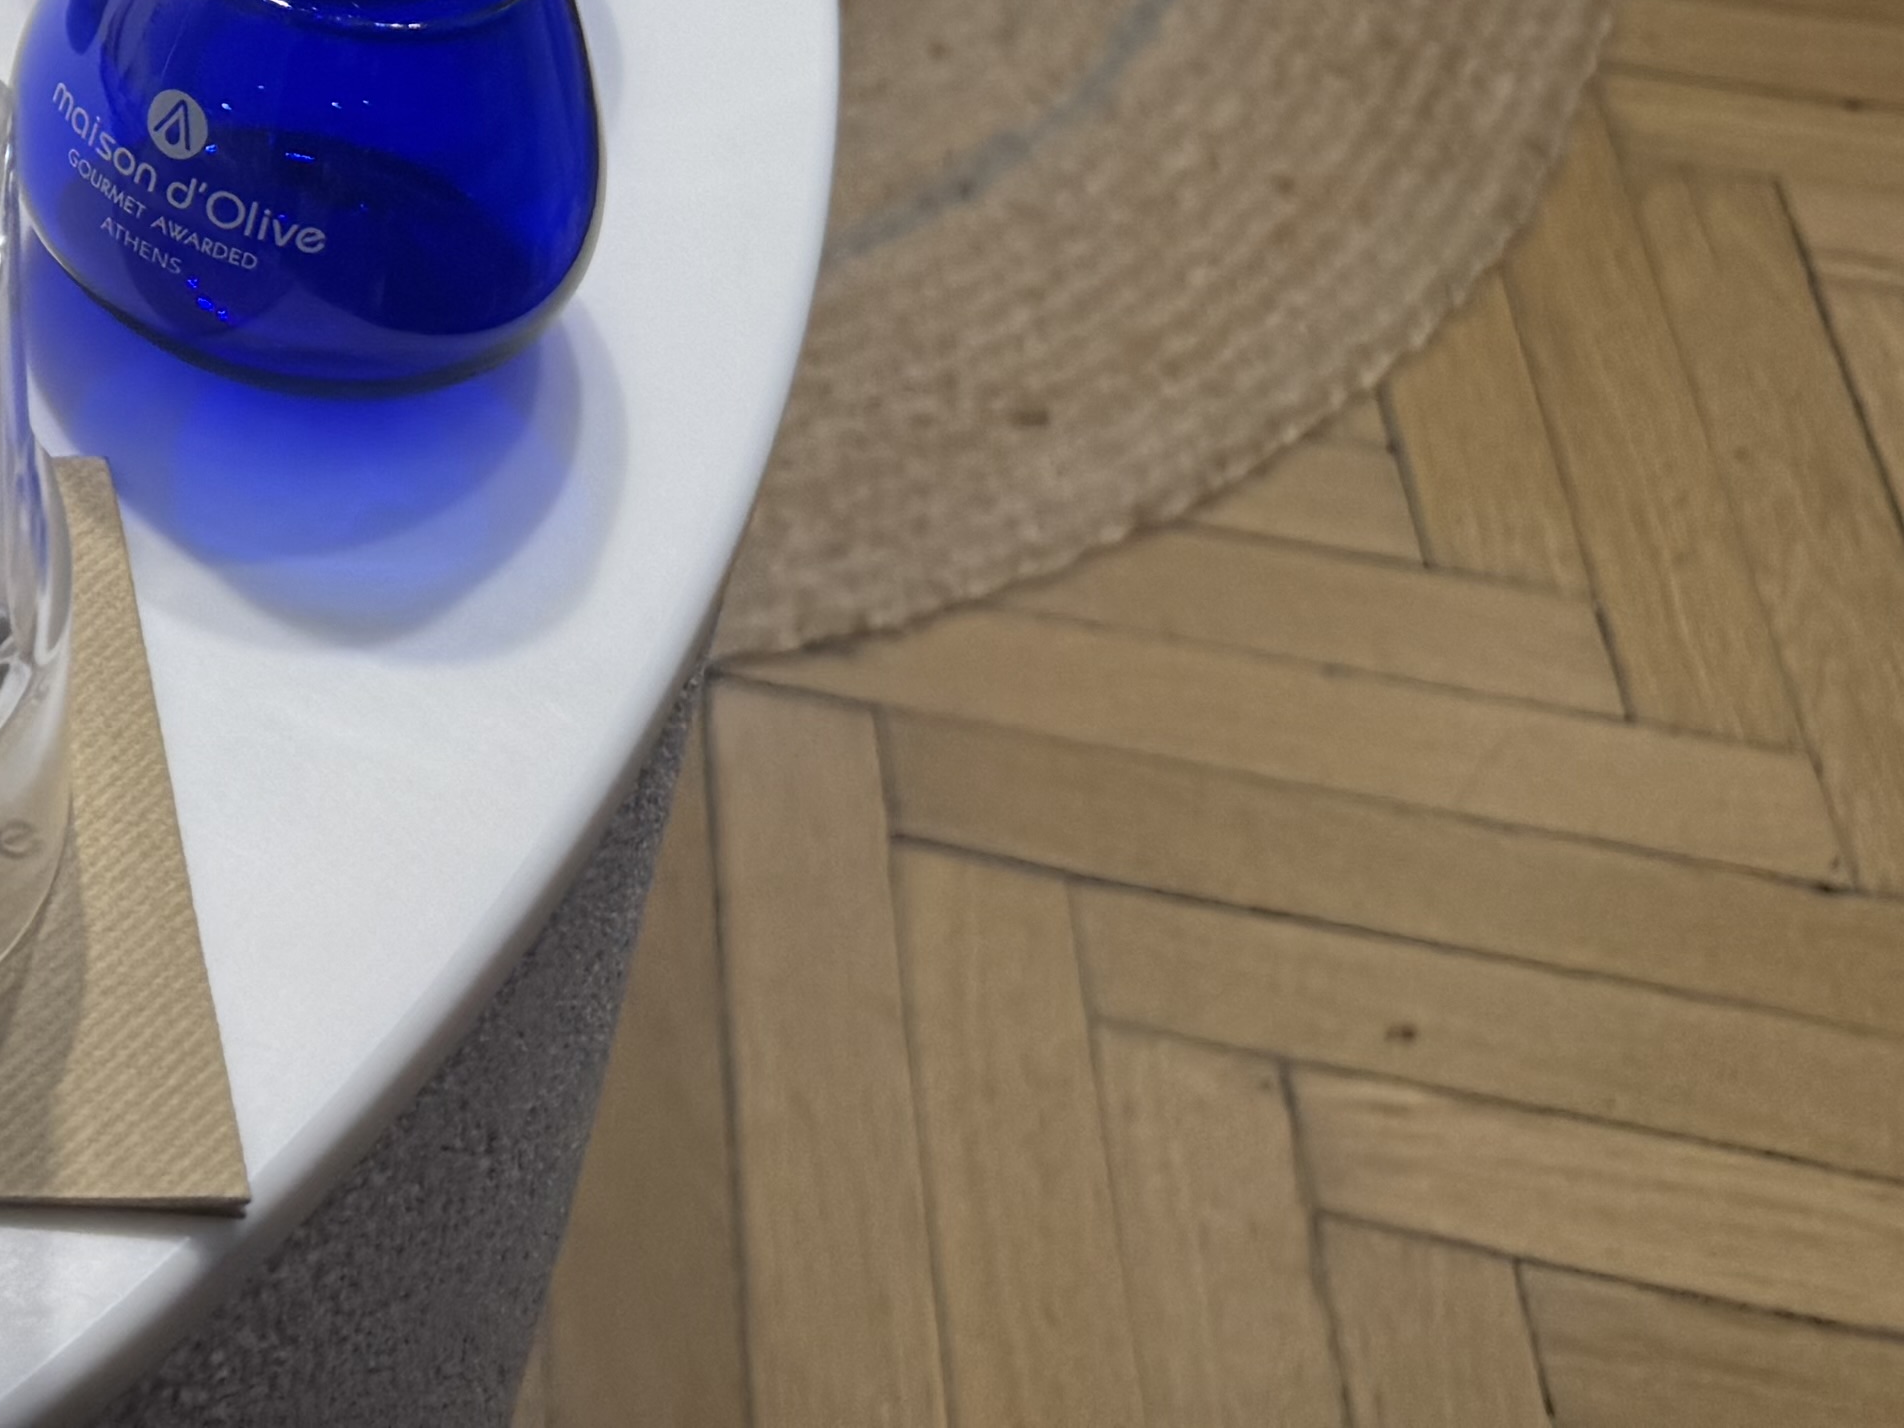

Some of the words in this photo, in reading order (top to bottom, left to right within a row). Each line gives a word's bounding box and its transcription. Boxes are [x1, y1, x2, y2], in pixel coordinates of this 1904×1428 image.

[52, 81, 157, 193] maison
[165, 177, 327, 254] d'Olive
[67, 147, 148, 220] GOURMET
[149, 215, 259, 271] AWARDED
[99, 216, 183, 275] ATHENS
